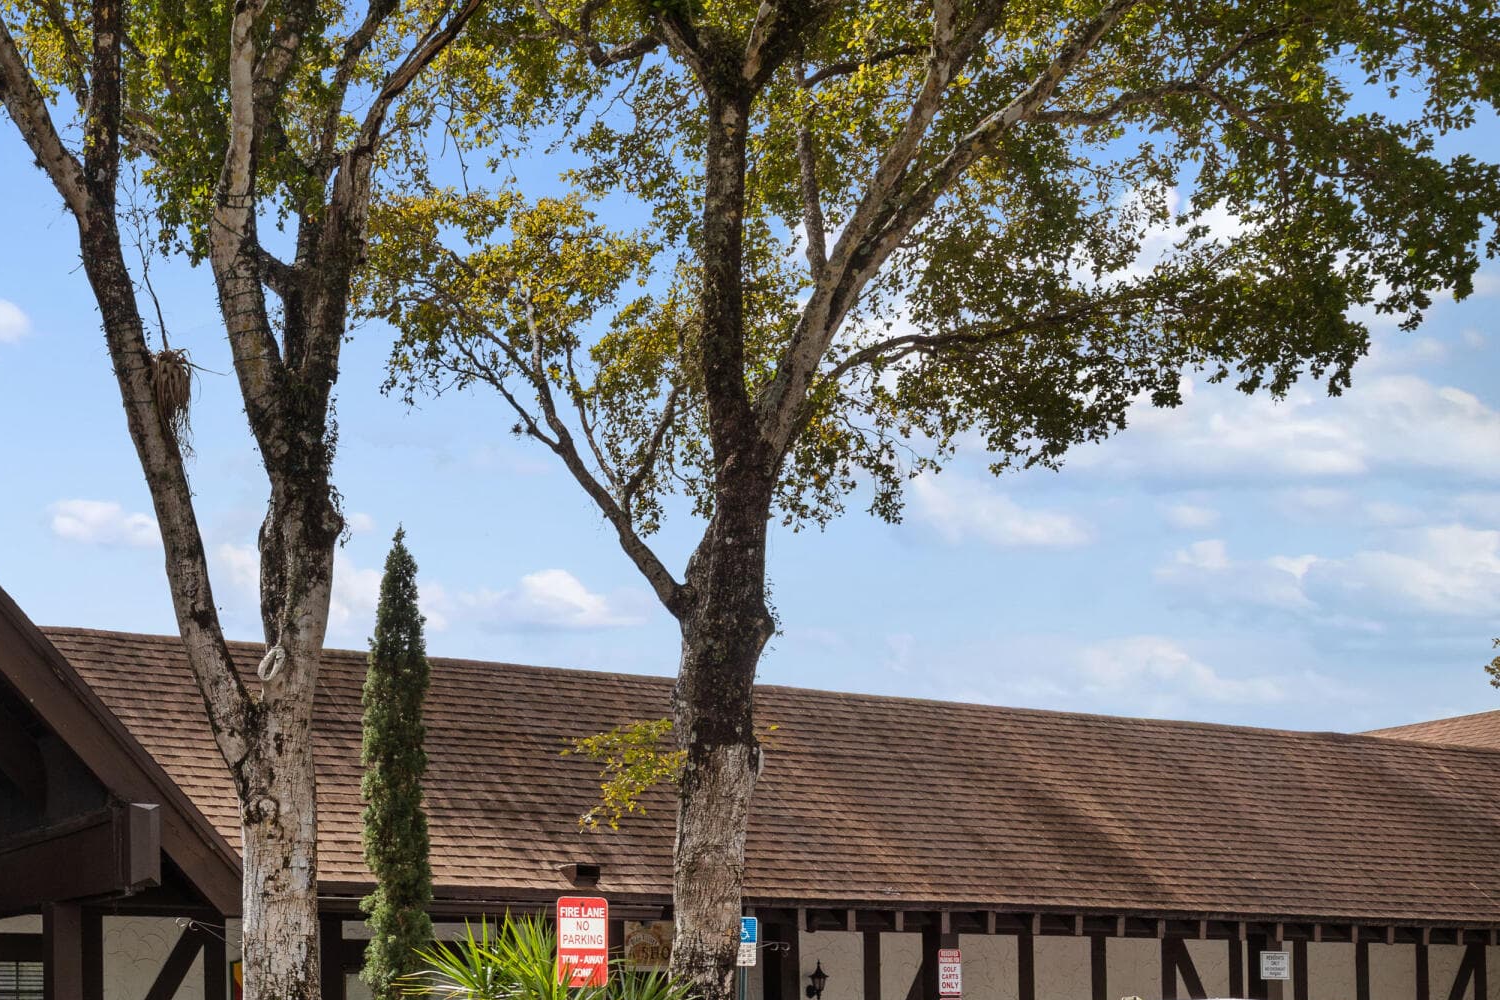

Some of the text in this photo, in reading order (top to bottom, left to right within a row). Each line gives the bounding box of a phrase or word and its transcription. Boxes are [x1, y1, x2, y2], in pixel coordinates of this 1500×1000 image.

[560, 907, 605, 918] FIRE LANE
[576, 920, 590, 931] NO
[563, 935, 603, 945] PARKING
[642, 945, 671, 960] SHO
